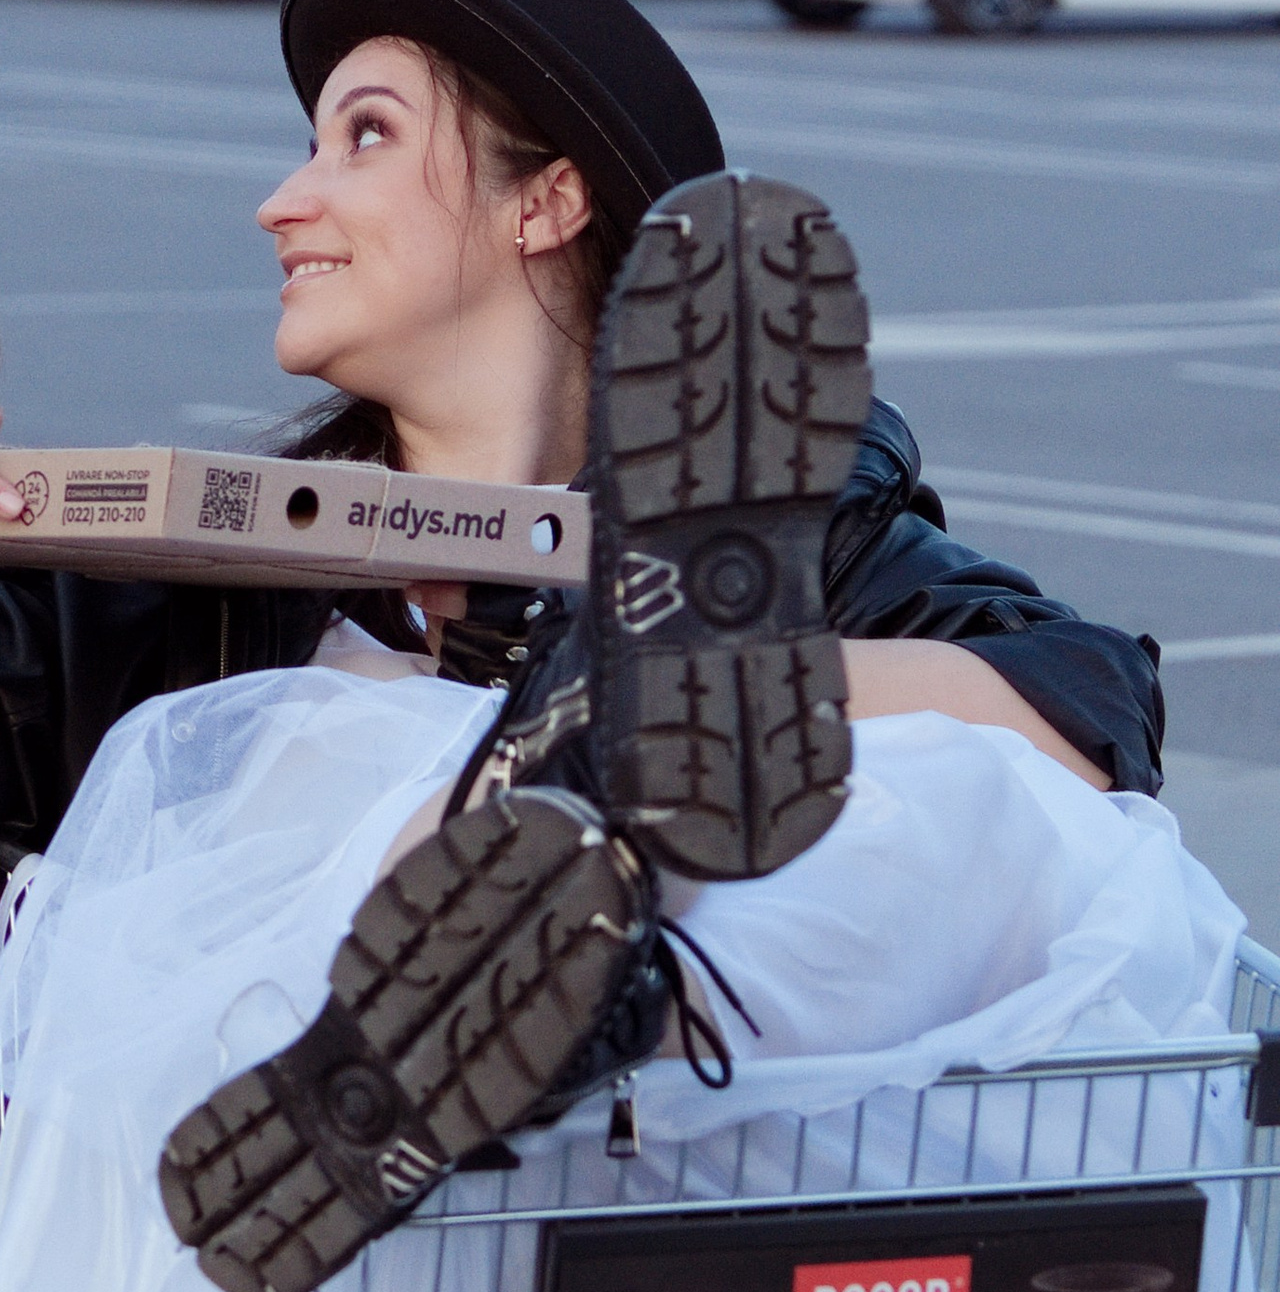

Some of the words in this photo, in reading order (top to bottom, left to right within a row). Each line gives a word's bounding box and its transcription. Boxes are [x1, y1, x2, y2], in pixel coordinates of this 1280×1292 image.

[66, 470, 101, 481] LIVRARE
[104, 470, 150, 480] NON-STOP
[28, 482, 40, 494] 24
[62, 506, 94, 526] (022)
[98, 507, 146, 522] 210-210
